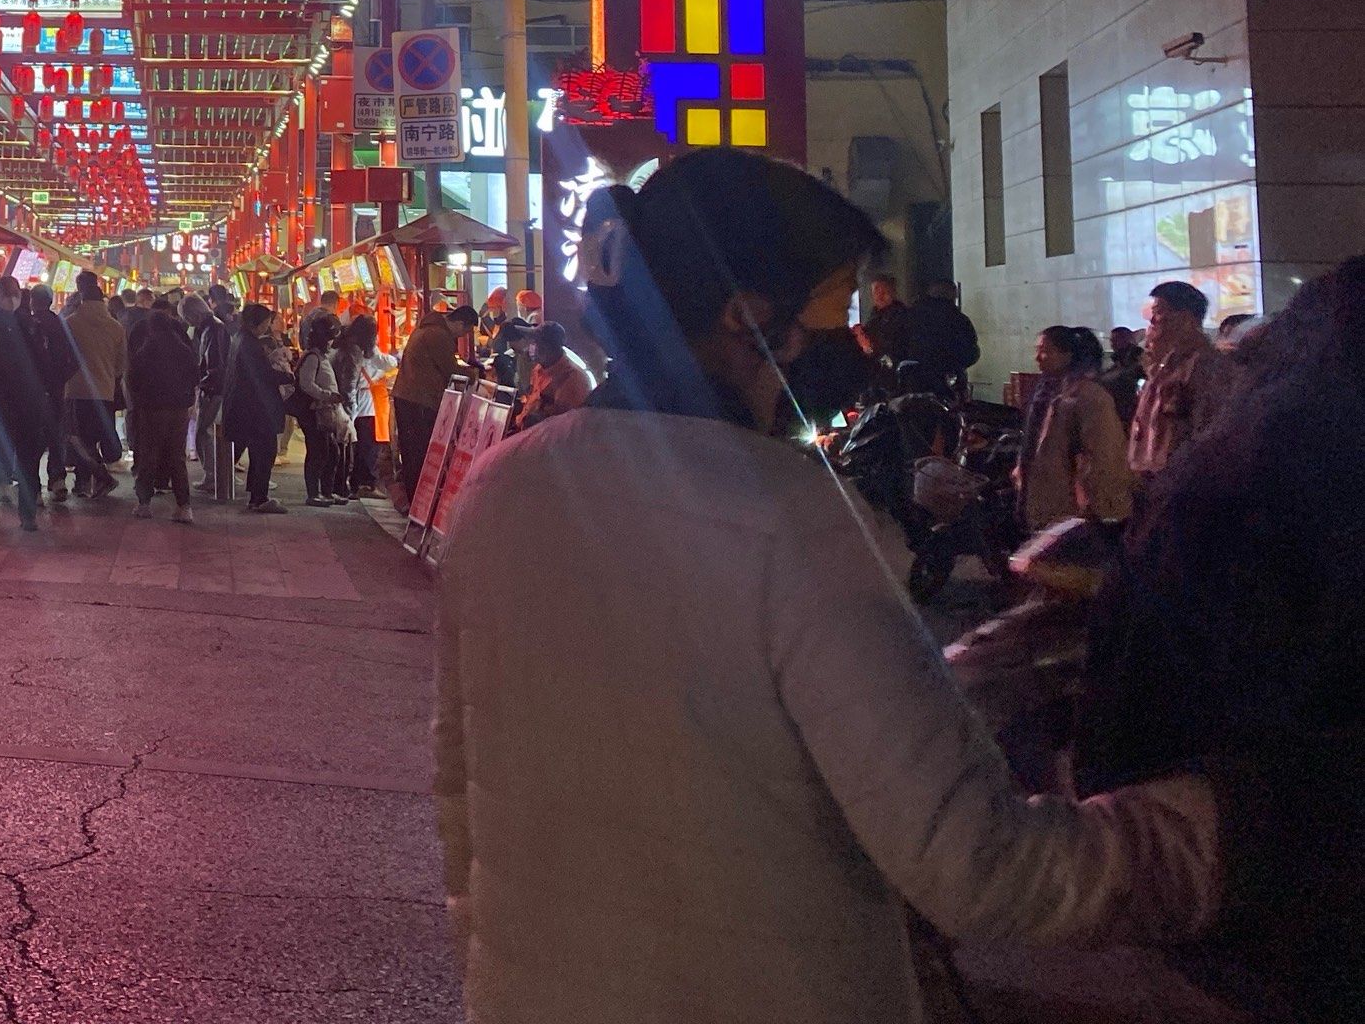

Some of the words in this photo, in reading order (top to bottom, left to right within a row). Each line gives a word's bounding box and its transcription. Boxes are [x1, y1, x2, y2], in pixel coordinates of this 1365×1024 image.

[402, 96, 455, 115] 严管路段
[404, 123, 455, 142] 南宁路
